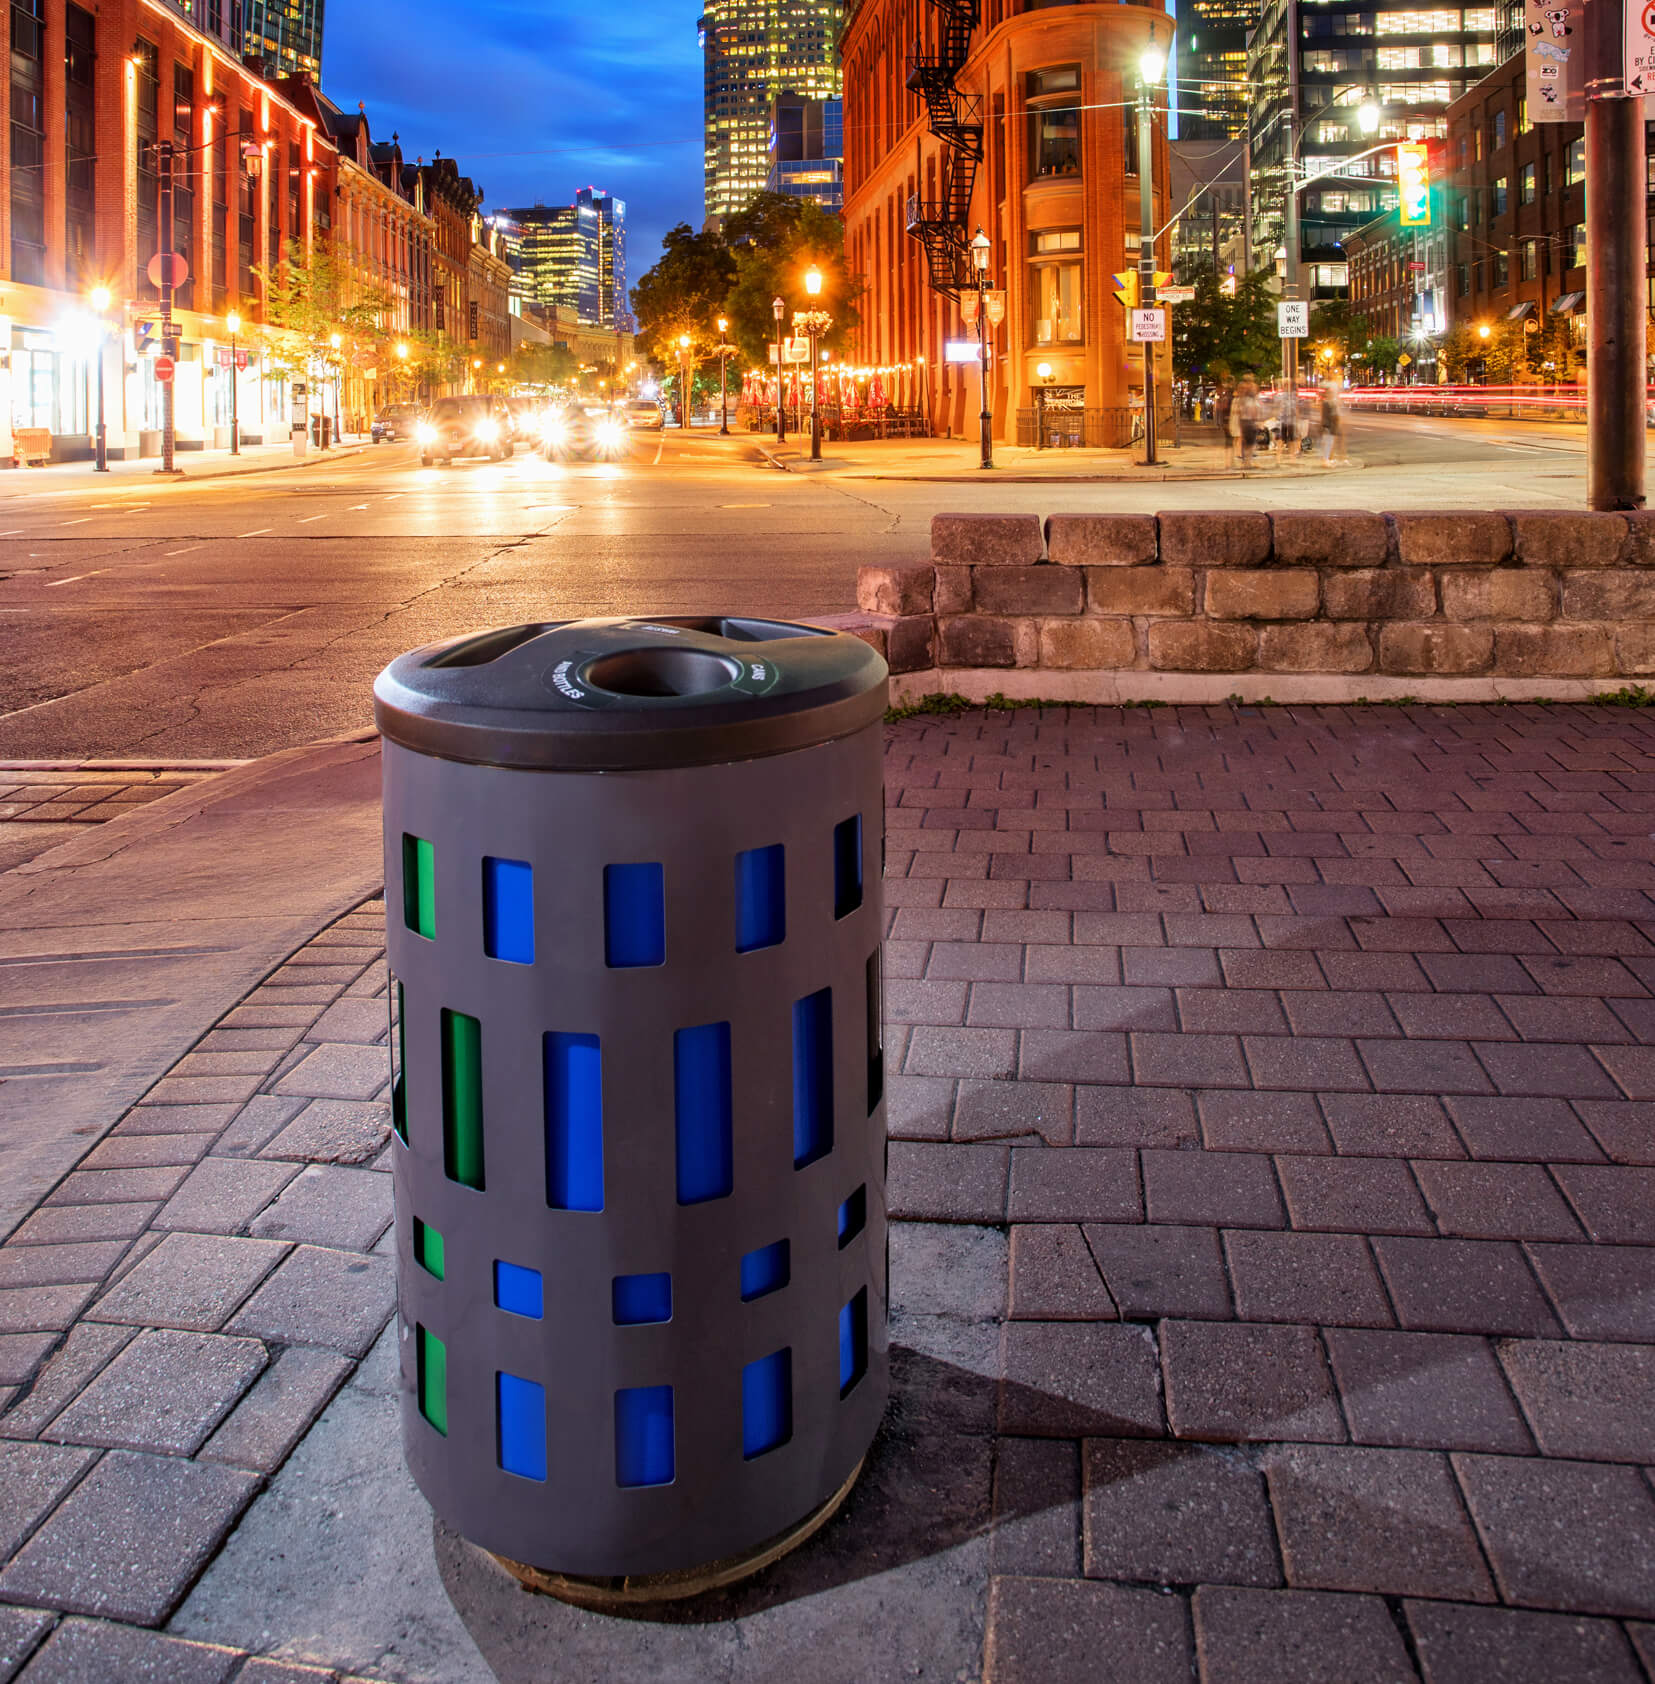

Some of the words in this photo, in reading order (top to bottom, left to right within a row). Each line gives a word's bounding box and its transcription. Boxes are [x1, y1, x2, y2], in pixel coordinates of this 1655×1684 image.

[1634, 57, 1645, 67] BY
[1285, 304, 1301, 313] ONE
[1143, 312, 1155, 322] NO
[1286, 315, 1300, 324] WAY
[1280, 326, 1306, 335] BEGINS
[552, 673, 585, 699] BOTTLES
